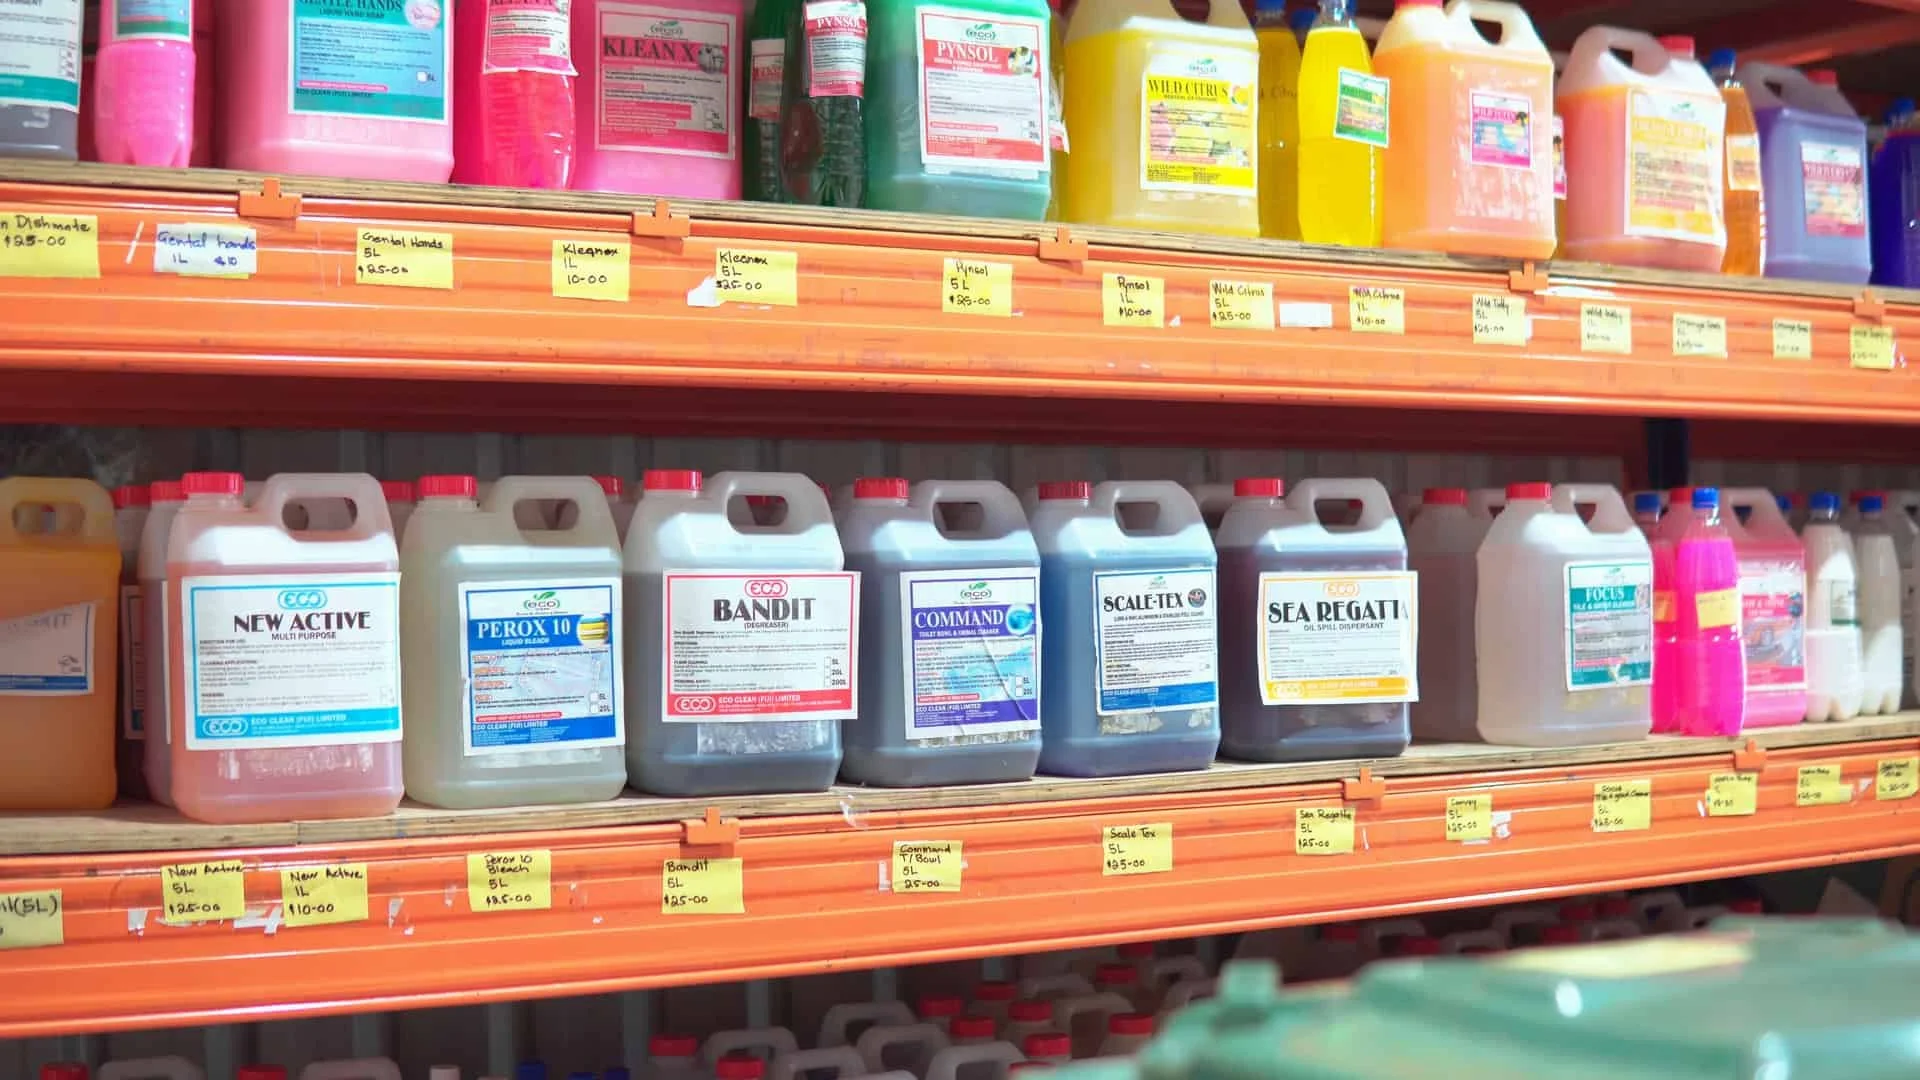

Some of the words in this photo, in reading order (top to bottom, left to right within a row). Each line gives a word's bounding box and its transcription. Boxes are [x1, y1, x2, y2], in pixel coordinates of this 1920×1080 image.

[603, 37, 675, 60] KLEAN
[682, 43, 696, 62] X
[937, 40, 998, 62] PYNSOL
[1149, 79, 1182, 94] WILD
[750, 582, 783, 595] ECO
[1585, 587, 1625, 601] FOCUS
[283, 592, 321, 608] ECO
[1103, 592, 1184, 612] SCALE-TEX
[714, 598, 816, 621] BANDIT
[1268, 601, 1311, 623] SEA
[234, 614, 284, 632] NEW
[289, 612, 371, 631] ACTIVE
[915, 610, 1003, 628] COMMAND
[1339, 622, 1384, 630] DISPERSANT
[271, 632, 296, 641] MULTI
[298, 631, 337, 640] PURPOSE
[477, 619, 547, 639] PEROX
[553, 618, 571, 636] 10
[681, 701, 710, 711] ECO
[209, 719, 243, 735] ECO
[900, 843, 952, 854] Command
[169, 866, 197, 878] New
[665, 858, 709, 873] Bandit
[290, 871, 318, 882] New
[172, 882, 194, 894] 5L
